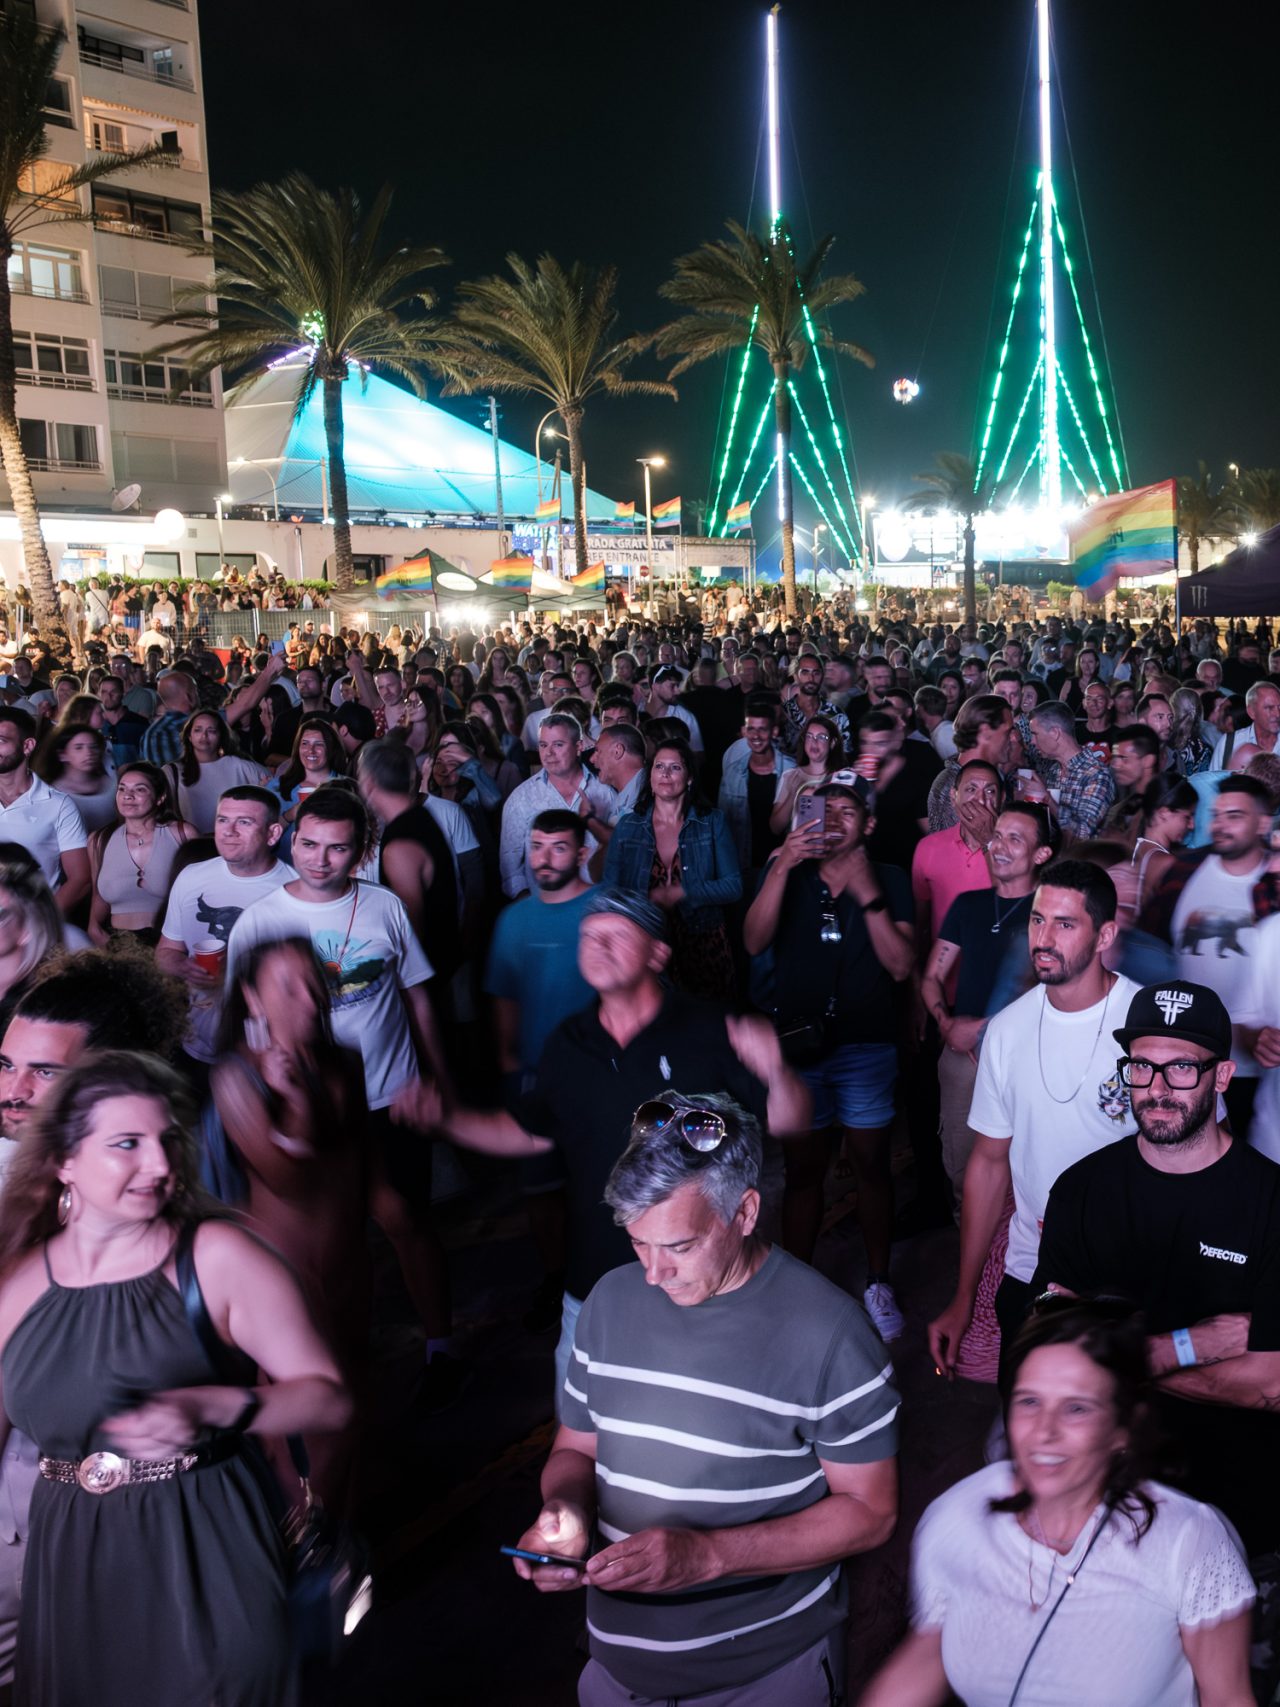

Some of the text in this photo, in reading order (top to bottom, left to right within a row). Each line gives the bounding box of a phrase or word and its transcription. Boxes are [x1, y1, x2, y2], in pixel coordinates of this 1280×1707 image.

[569, 538, 616, 549] ERADA
[606, 552, 660, 562] ENTRANE
[1155, 990, 1193, 1005] FALLEN
[1200, 1241, 1247, 1264] DEFECTED
